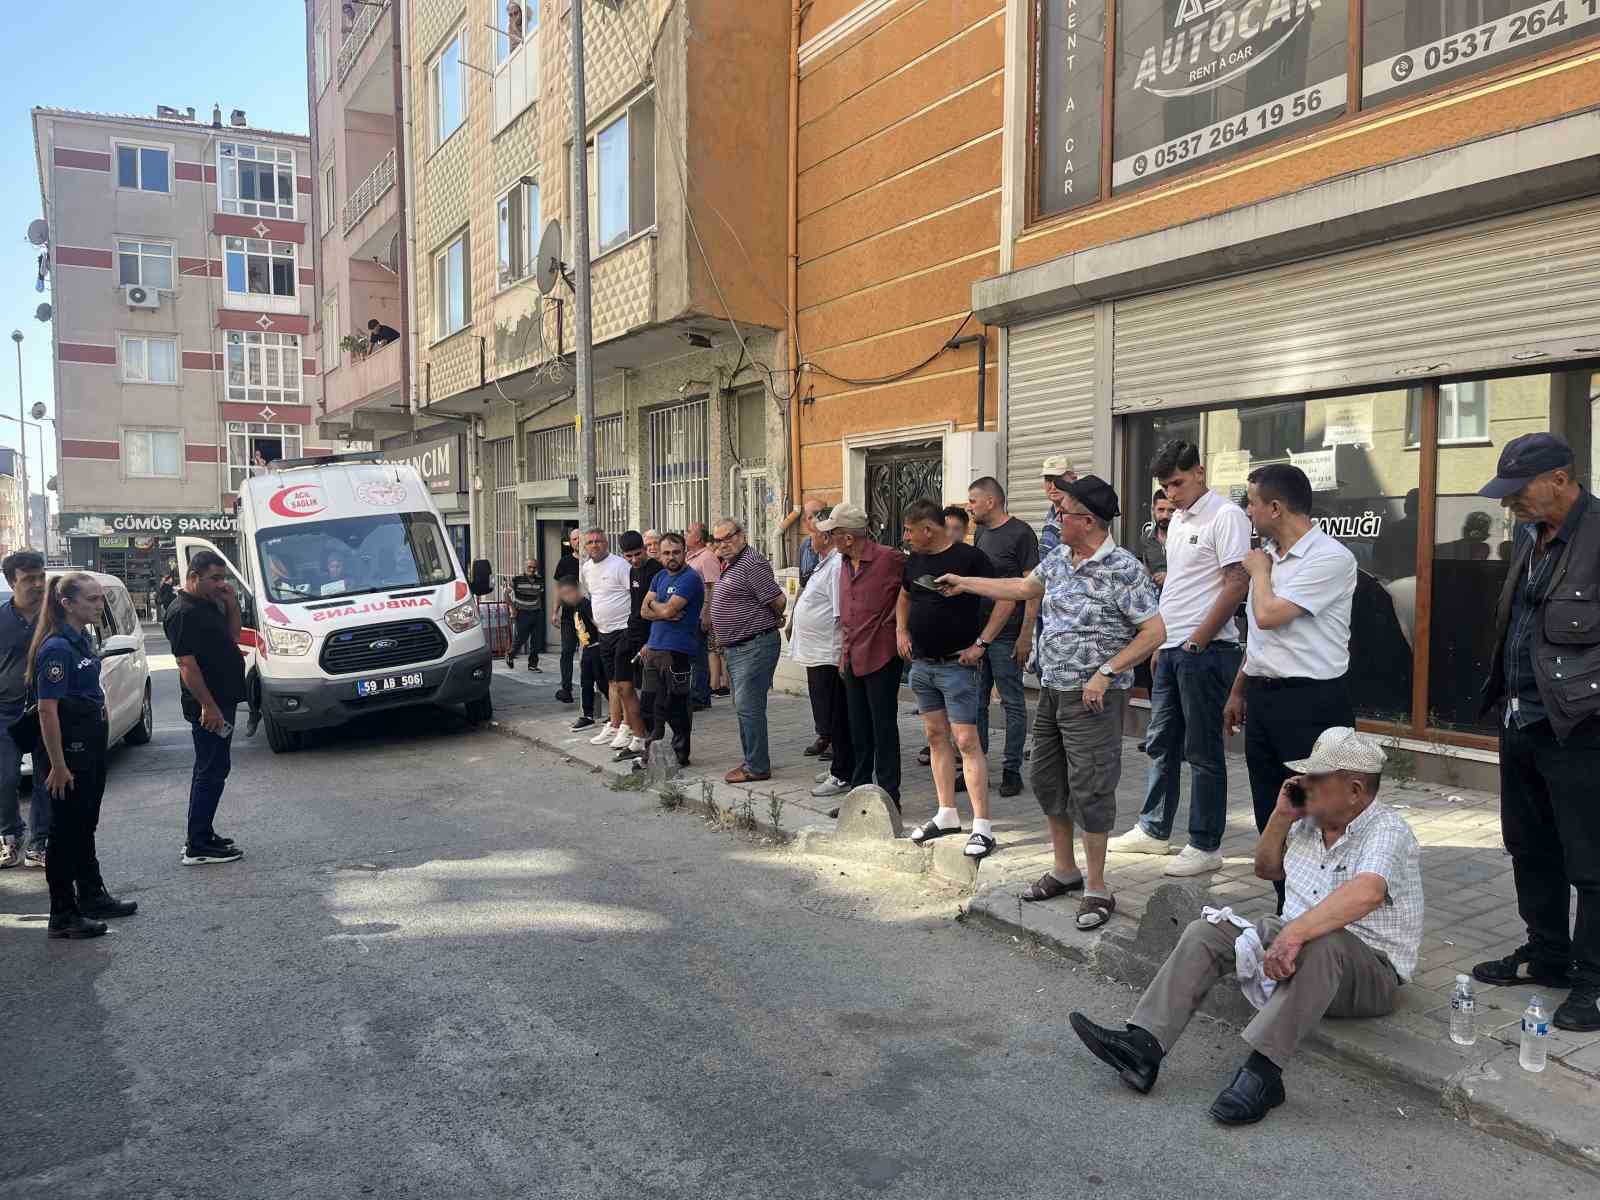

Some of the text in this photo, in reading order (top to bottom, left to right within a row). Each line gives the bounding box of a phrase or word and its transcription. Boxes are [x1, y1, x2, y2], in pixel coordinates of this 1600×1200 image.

[1424, 25, 1498, 71] 0537
[1508, 0, 1568, 43] 264
[1188, 46, 1253, 82] RENT A CAR
[1065, 96, 1075, 112] A
[1154, 88, 1322, 168] 0537 264 19 56
[1064, 137, 1075, 195] CAR
[114, 515, 172, 533] GÜMÜŞ
[364, 674, 420, 692] 59 AB 506
